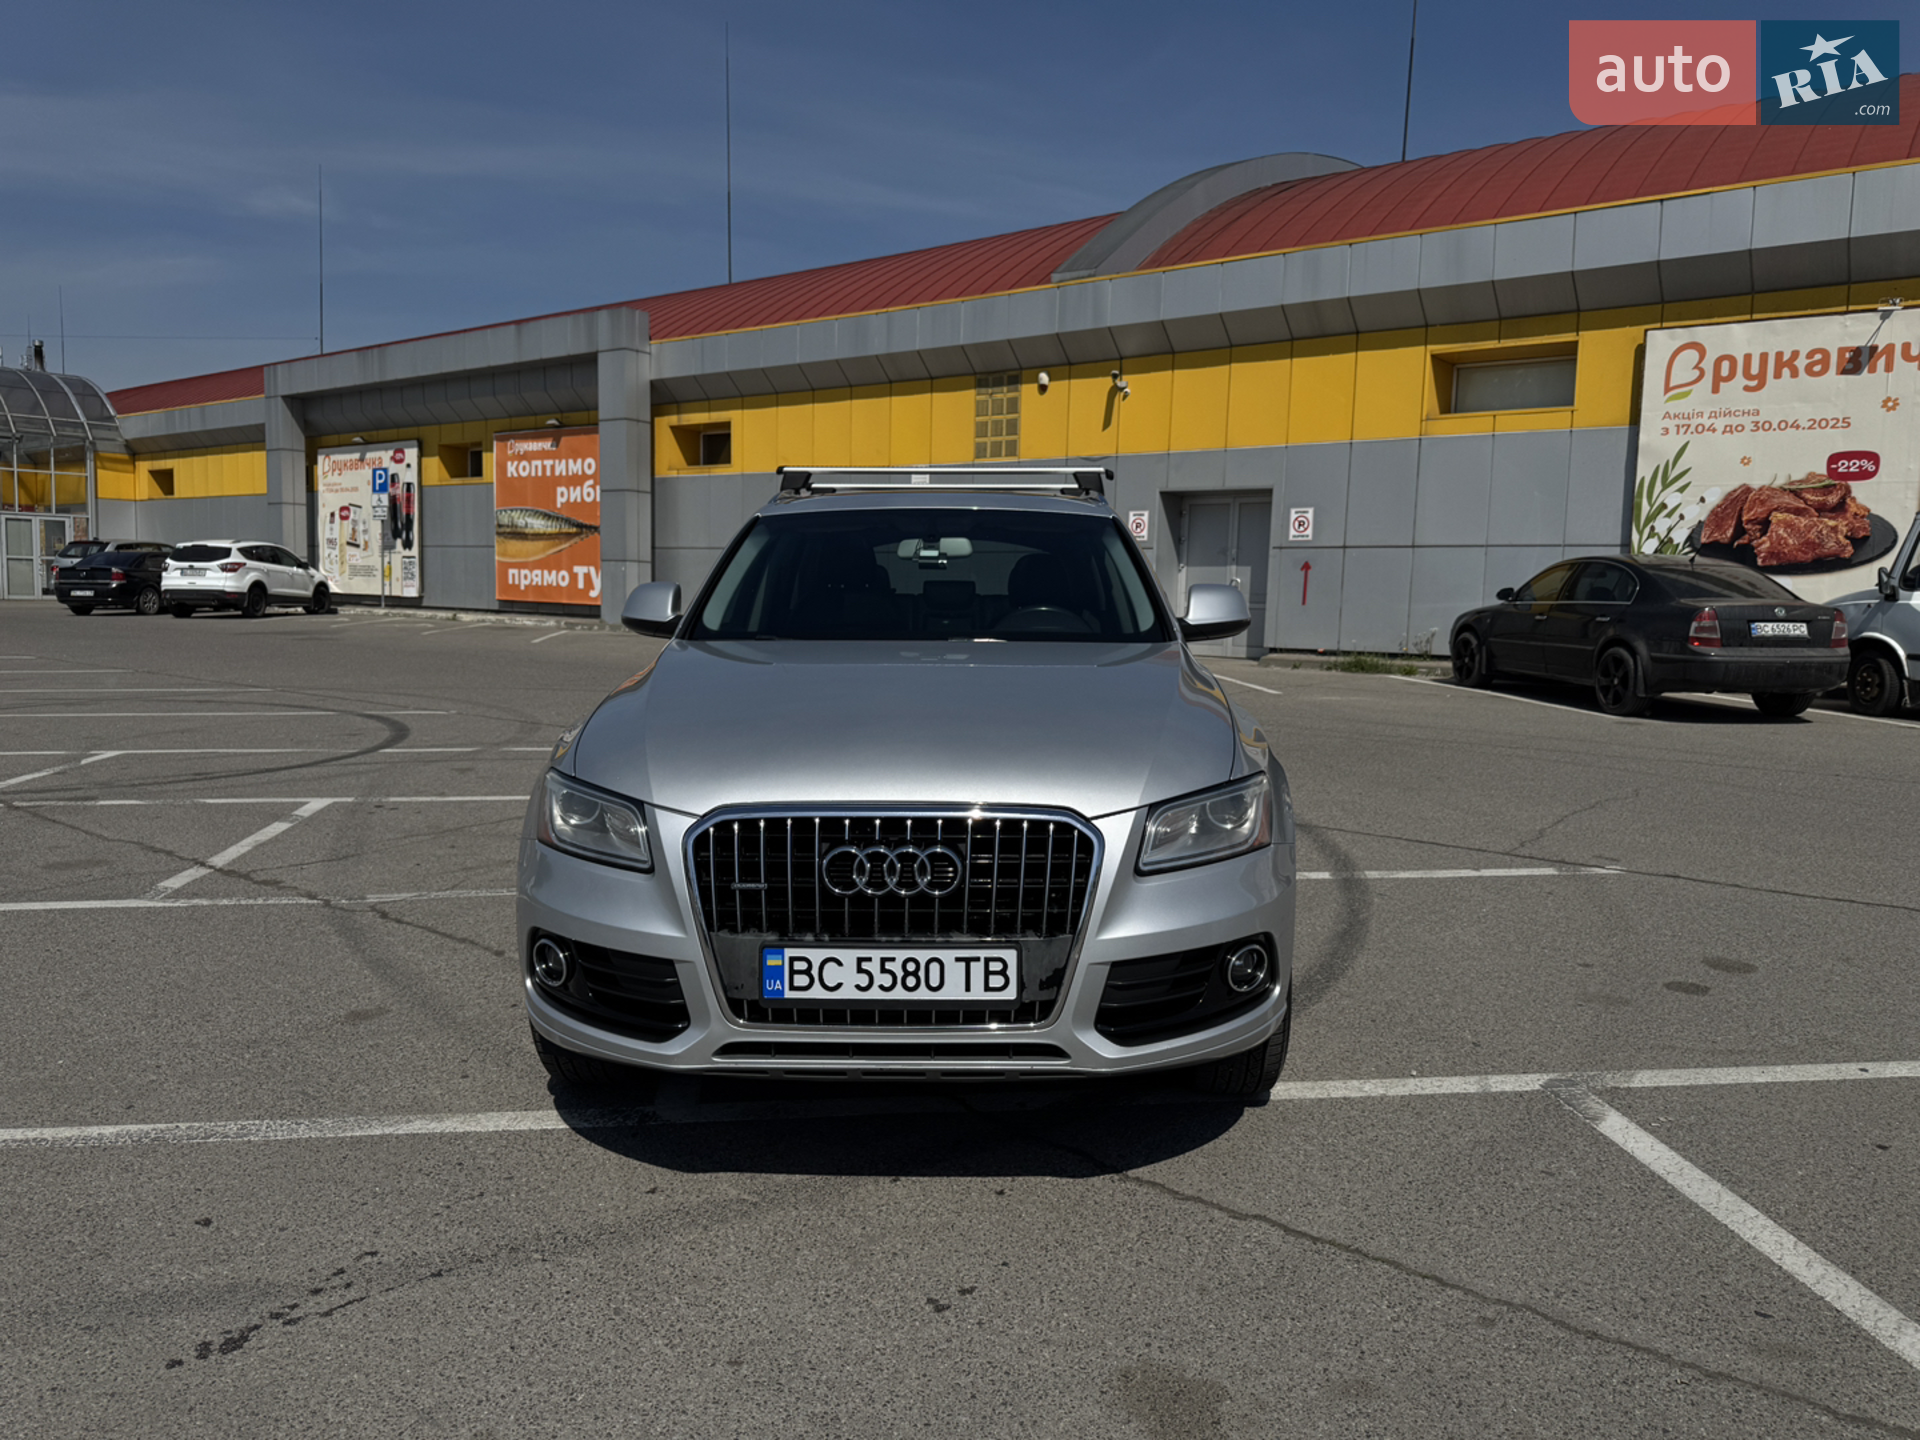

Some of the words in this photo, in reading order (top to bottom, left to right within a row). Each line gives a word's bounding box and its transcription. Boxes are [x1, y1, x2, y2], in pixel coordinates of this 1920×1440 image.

[1661, 409, 1704, 422] Акція
[1707, 407, 1760, 420] дійсна
[1660, 426, 1670, 436] з
[1674, 423, 1717, 436] 17.04
[1721, 422, 1745, 436] до
[1750, 417, 1851, 433] 30.04.2025
[506, 457, 597, 478] коптимо
[1829, 459, 1876, 473] -22%
[507, 568, 571, 590] прямо
[1756, 624, 1770, 634] BC
[1771, 624, 1792, 634] 6526
[788, 956, 844, 992] BC
[854, 956, 945, 993] 5580
[954, 956, 1010, 992] TB
[766, 979, 782, 990] UA
